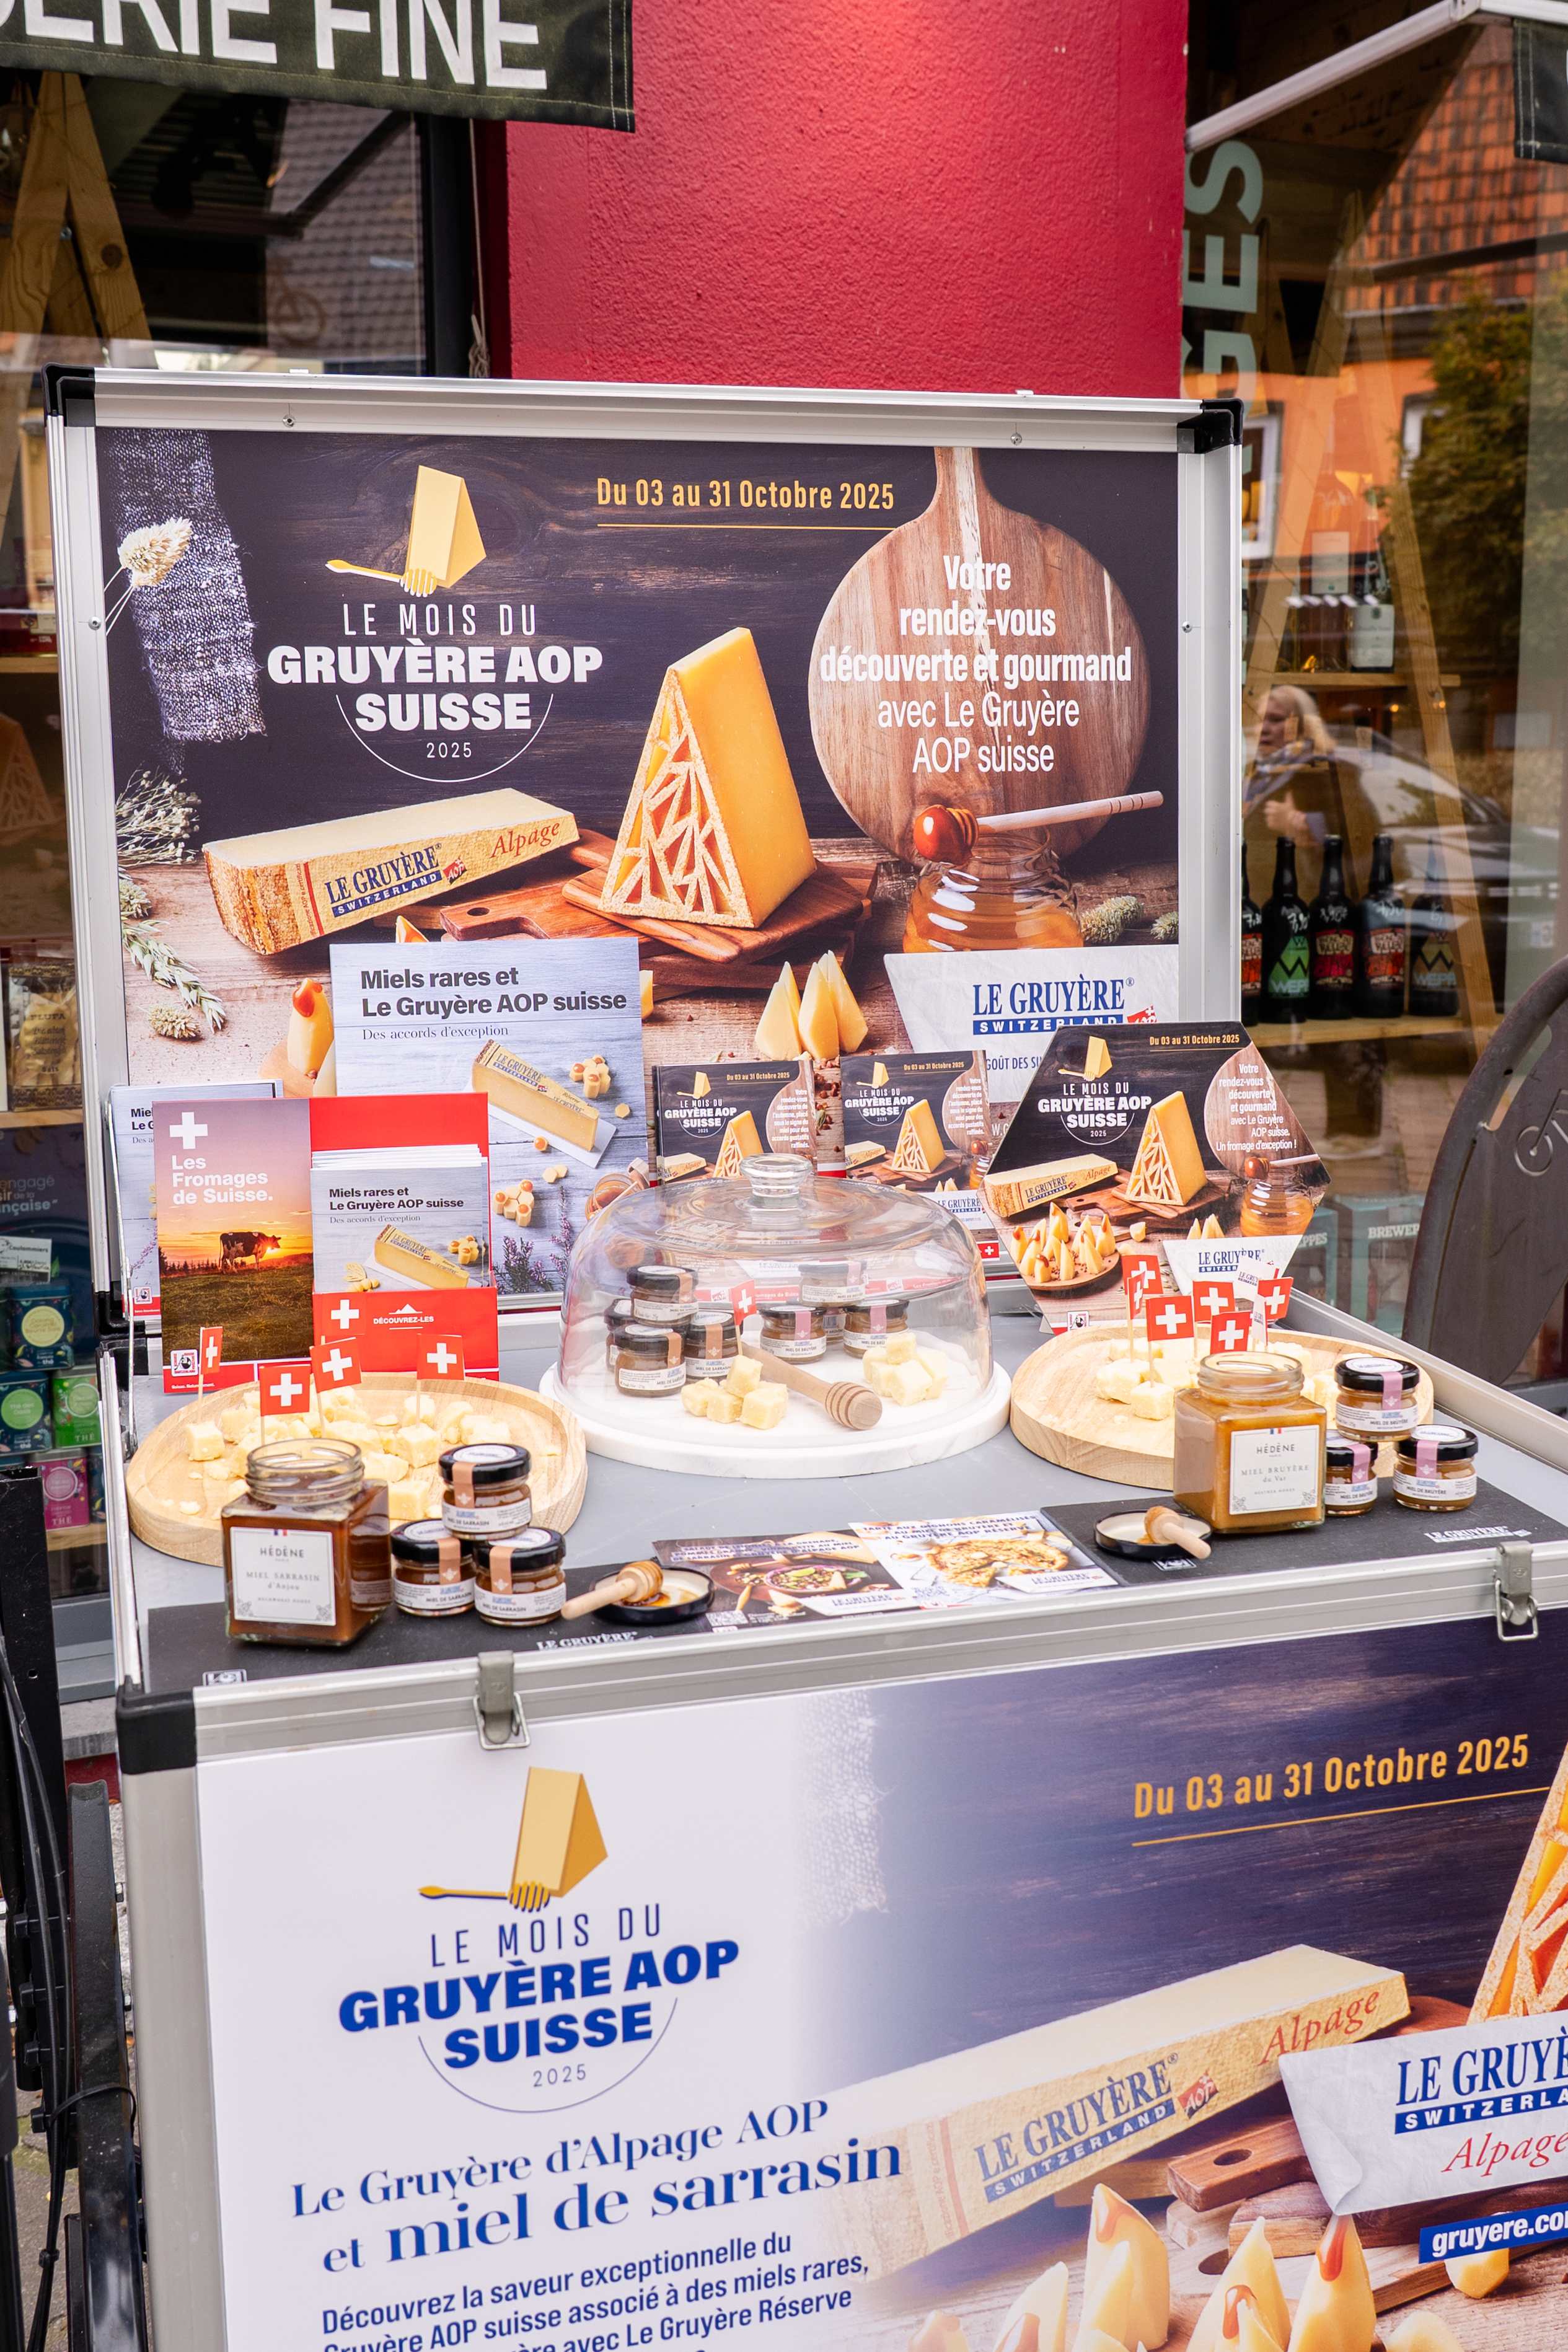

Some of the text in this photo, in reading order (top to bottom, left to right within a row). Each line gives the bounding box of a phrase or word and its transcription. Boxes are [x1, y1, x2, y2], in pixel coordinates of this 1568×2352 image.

[315, 0, 548, 90] FINE
[597, 477, 894, 510] Du 03 au 31 Octobre 2025
[944, 555, 1011, 591] Votre
[343, 603, 536, 636] LE MOIS DU
[900, 602, 1056, 637] rendez-vous
[267, 638, 603, 684] GRUYÈRE AOP
[820, 646, 1132, 690] découverte et gourmand
[355, 693, 532, 732] SUISSE
[878, 688, 1080, 737] avec Le Gruyère
[426, 742, 472, 759] 2025
[912, 736, 1055, 773] AOP suisse
[490, 822, 561, 859] Alpage
[324, 876, 352, 905] LE
[337, 873, 438, 915] SWITZERLAND
[361, 966, 519, 990] Miels rares et
[362, 990, 627, 1020] Le Gruyère AOP suisse
[972, 983, 1002, 1016] LE
[362, 1024, 509, 1042] Des accords d'exception
[1150, 1036, 1159, 1046] Du
[1161, 1036, 1170, 1046] 03
[1183, 1036, 1190, 1045] 31
[1192, 1035, 1220, 1045] Octobre
[1222, 1034, 1240, 1044] 2025
[1219, 1077, 1264, 1087] rendez-vous
[1239, 1064, 1259, 1074] Votre
[680, 1099, 723, 1108] LE MOIS DU
[1037, 1095, 1152, 1112] GRUYÈRE AOP
[1064, 1082, 1129, 1096] LE MOIS DU
[1229, 1089, 1271, 1099] découverte
[664, 1107, 738, 1119] GRUYÈRE AOP
[1067, 1113, 1127, 1129] SUISSE
[1230, 1102, 1277, 1114] et gourmand
[1230, 1114, 1284, 1127] avec Le Gruyère
[683, 1118, 721, 1129] SUISSE
[1090, 1130, 1107, 1138] 2025
[1251, 1127, 1267, 1137] AOP
[1216, 1142, 1226, 1151] Un
[1227, 1140, 1254, 1153] fromage
[1256, 1139, 1293, 1152] d'exception
[171, 1155, 207, 1171] Les
[172, 1171, 268, 1191] Fromages
[173, 1186, 274, 1205] de Suisse.
[329, 1187, 409, 1198] Miels rares et
[330, 1198, 464, 1212] Le Gruyère AOP suisse
[330, 1214, 421, 1224] Des accords d'exception
[1199, 1252, 1210, 1265] LE
[373, 1316, 434, 1324] DÉCOUVREZ-LES
[1241, 1464, 1310, 1476] MIEL BRUYÈRE
[1134, 1733, 1529, 1818] Du 03 au 31 Octobre 2025
[431, 1902, 662, 1969] LE MOIS DU
[338, 1939, 739, 2033] GRUYÈRE AOP
[444, 2001, 653, 2070] SUISSE
[1258, 1989, 1381, 2065] Alpage
[532, 2064, 587, 2088] 2025
[1396, 2055, 1442, 2106] LE
[291, 2098, 829, 2219] Le Gruyère d'Alpage AOP
[974, 2133, 1020, 2183] LE
[994, 2104, 1168, 2196] SWITZERLAND
[1441, 2131, 1568, 2178] Alpage
[322, 2237, 367, 2273] et
[386, 2191, 533, 2263] miel
[553, 2181, 630, 2234] de
[650, 2137, 903, 2220] sarrasin
[1432, 2209, 1568, 2258] gruyere.co
[322, 2231, 792, 2335] Découvrez la saveur exceptionnelle du
[429, 2319, 478, 2350] AOP
[483, 2309, 562, 2340] suisse
[568, 2286, 659, 2324] associé
[665, 2282, 680, 2307] à
[685, 2278, 728, 2304] des
[733, 2263, 796, 2295] miels
[802, 2255, 870, 2283] rares,
[626, 2323, 654, 2348] Le
[659, 2307, 752, 2342] Gruyère
[759, 2288, 853, 2324] Réserve
